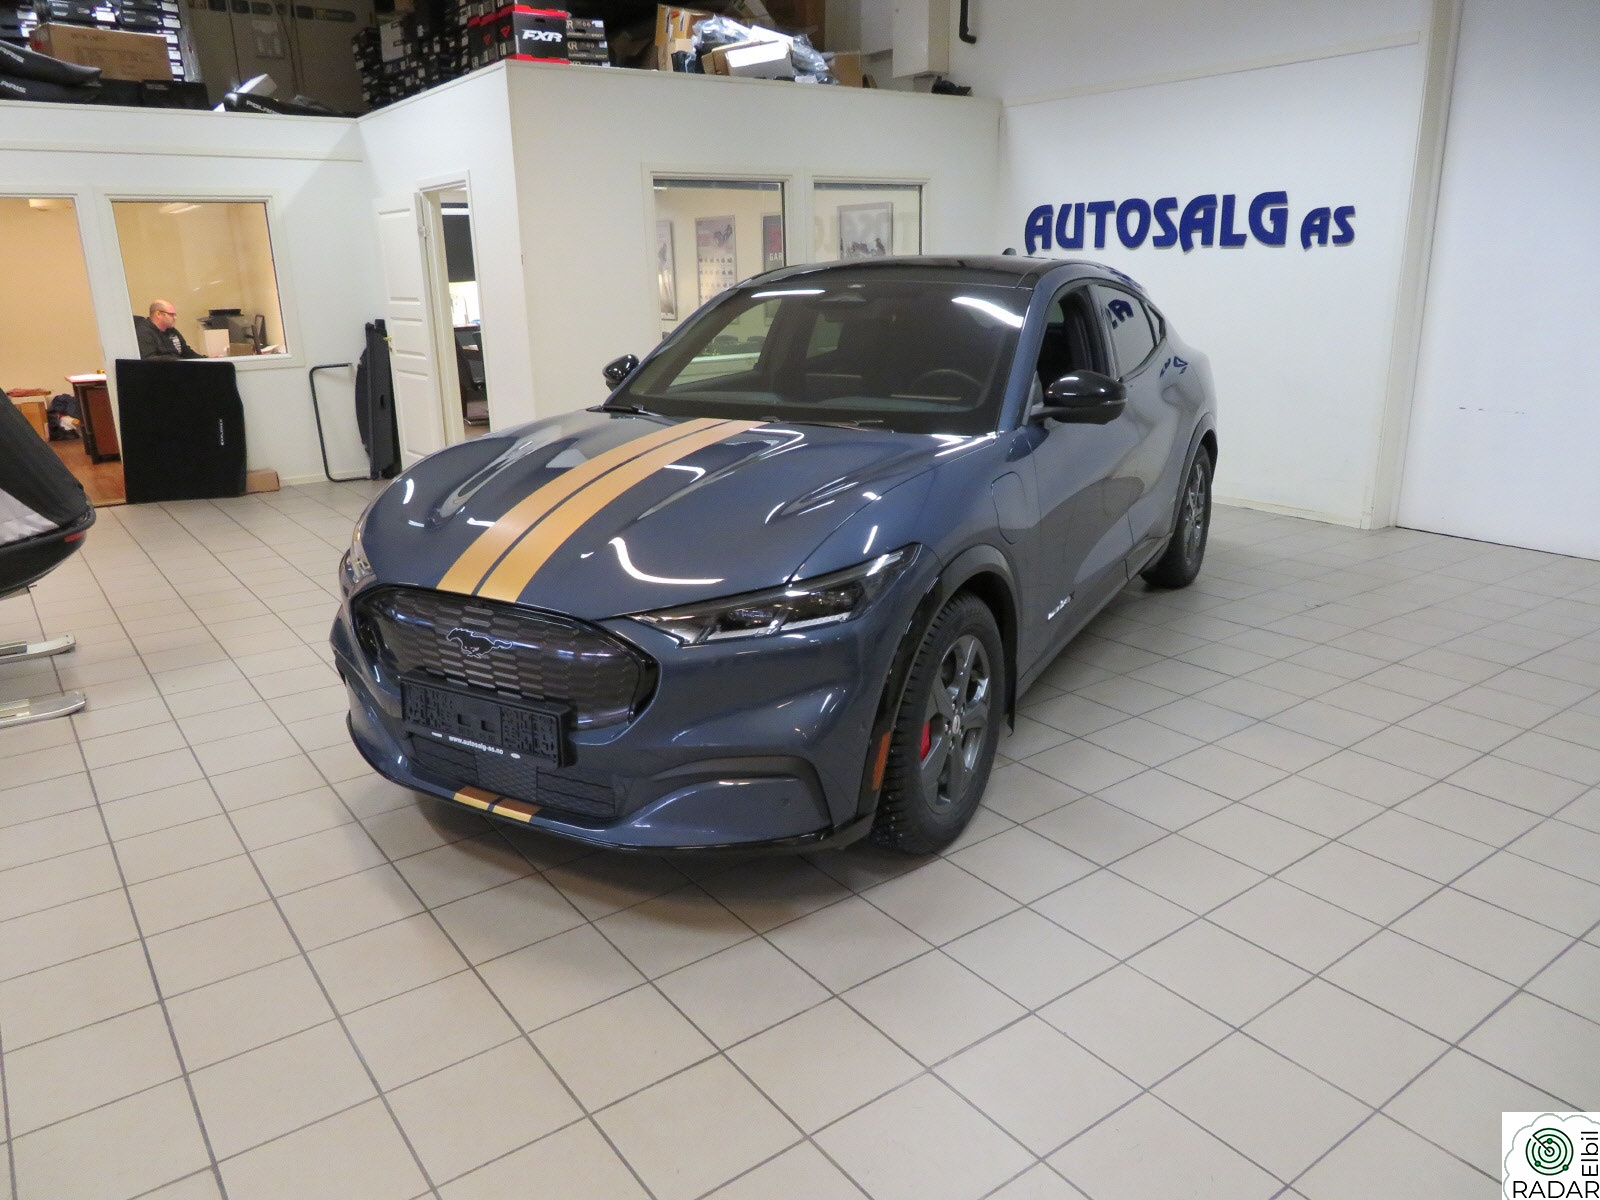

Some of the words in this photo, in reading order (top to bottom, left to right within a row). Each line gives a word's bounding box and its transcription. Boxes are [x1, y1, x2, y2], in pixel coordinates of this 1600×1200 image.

[522, 28, 563, 42] FXR
[1024, 191, 1289, 255] AUTOSALG
[1301, 205, 1356, 250] AS
